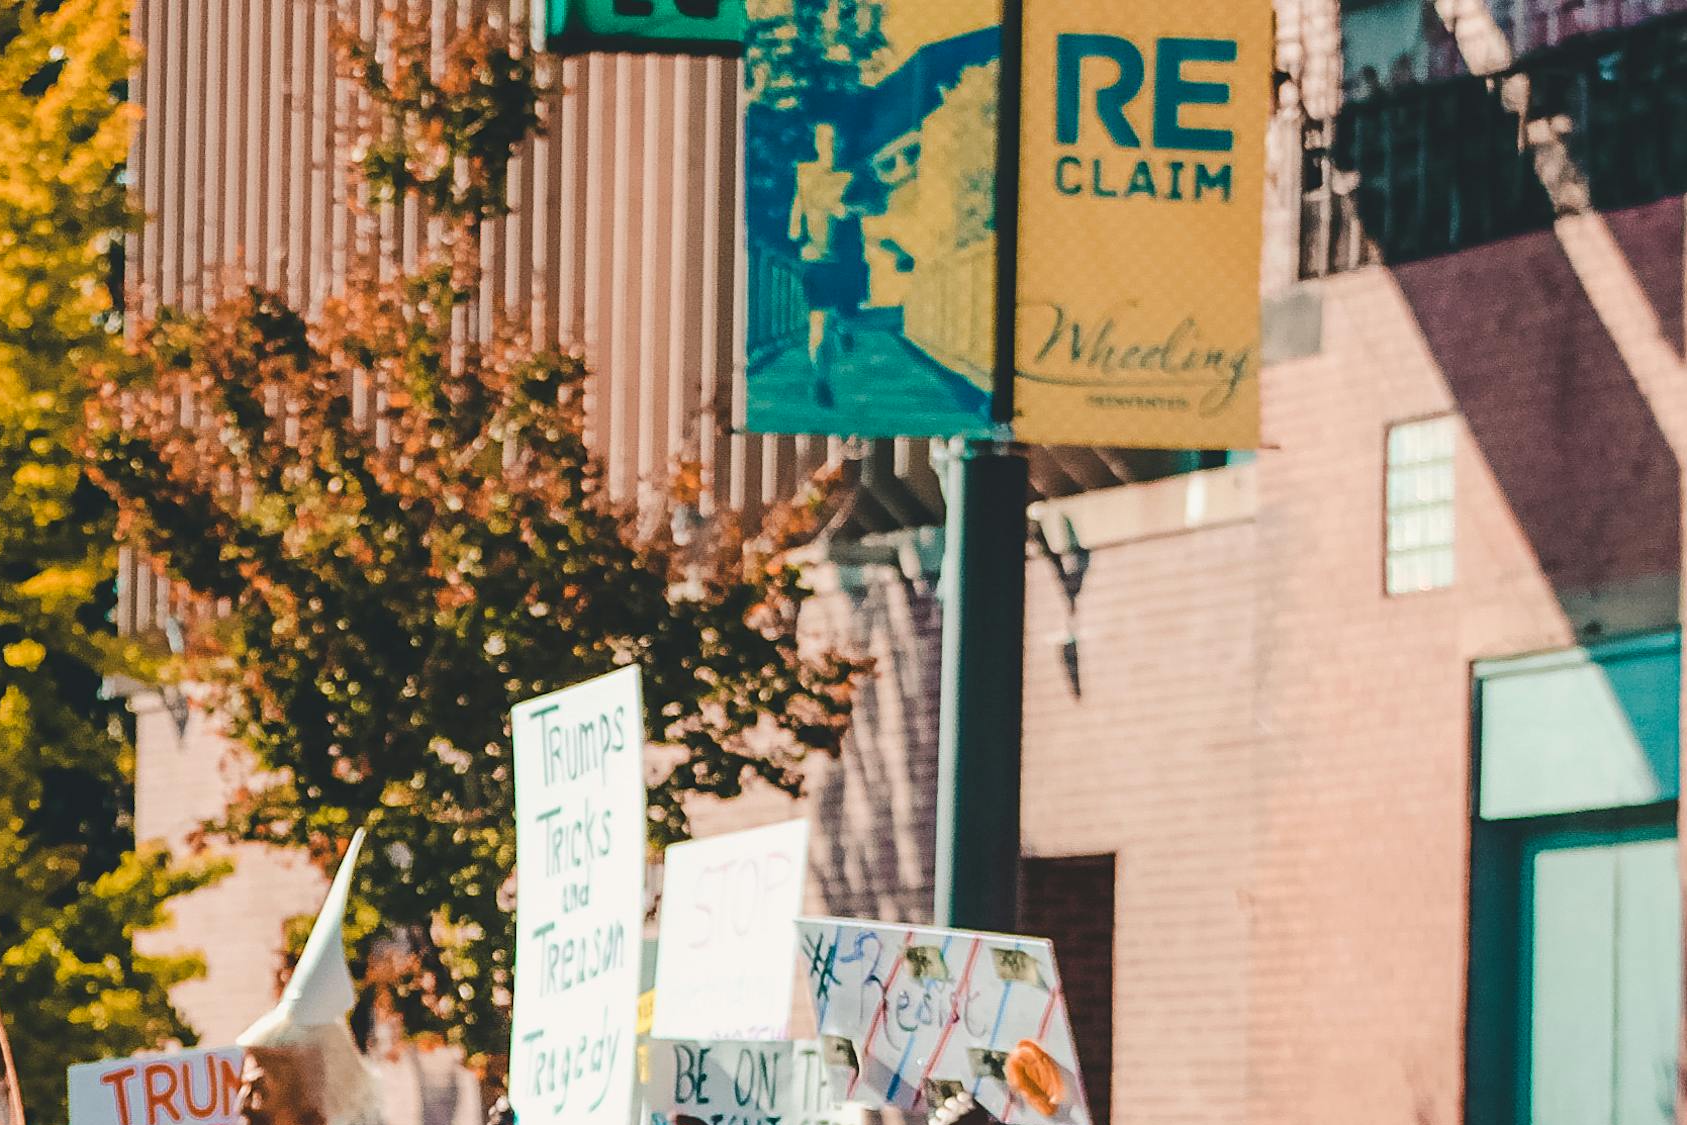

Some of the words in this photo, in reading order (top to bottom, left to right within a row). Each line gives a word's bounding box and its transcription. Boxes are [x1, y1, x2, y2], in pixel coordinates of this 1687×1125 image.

[1055, 33, 1237, 152] RE
[1055, 155, 1233, 201] CLAIM
[1014, 298, 1254, 419] Wheeling
[688, 850, 793, 950] STOP
[673, 1044, 712, 1104] BE
[734, 1048, 782, 1112] ON
